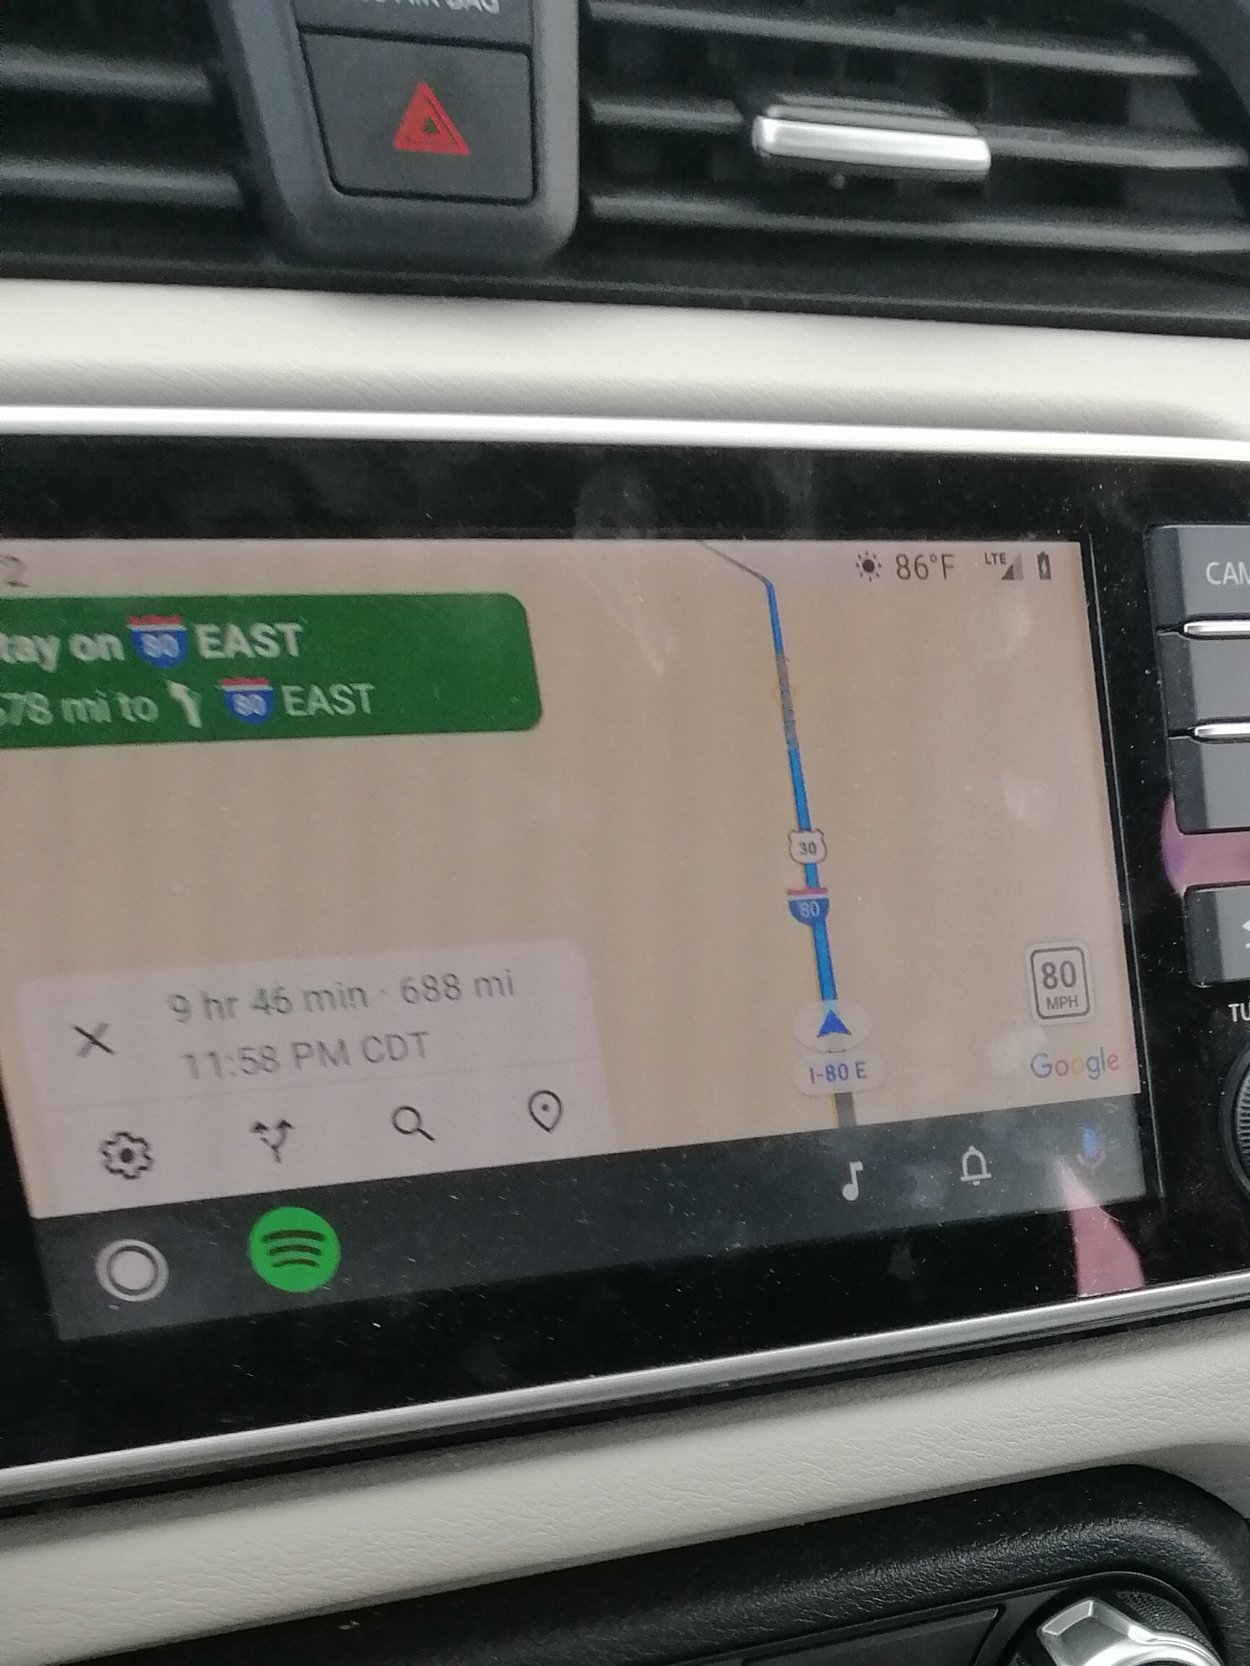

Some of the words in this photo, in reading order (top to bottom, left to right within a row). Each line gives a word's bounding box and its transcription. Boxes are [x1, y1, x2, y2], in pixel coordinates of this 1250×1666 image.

[896, 552, 955, 581] 86°F
[984, 552, 1007, 565] LTE
[68, 633, 125, 662] on
[194, 622, 303, 659] EAST
[61, 690, 112, 724] mi
[117, 690, 159, 723] to
[281, 682, 374, 716] EAST
[799, 842, 818, 856] 30
[800, 902, 820, 918] 80
[1041, 960, 1078, 989] 80
[167, 993, 192, 1024] 9
[200, 989, 239, 1021] hr
[302, 981, 369, 1013] min
[399, 973, 462, 1004] 688
[472, 969, 515, 998] mi
[1045, 994, 1079, 1011] MPH
[178, 1045, 281, 1080] 11:58
[290, 1038, 350, 1070] PM
[360, 1031, 430, 1064] CDT
[1030, 1046, 1121, 1080] Google
[808, 1063, 850, 1083] I-80
[854, 1061, 868, 1080] E
